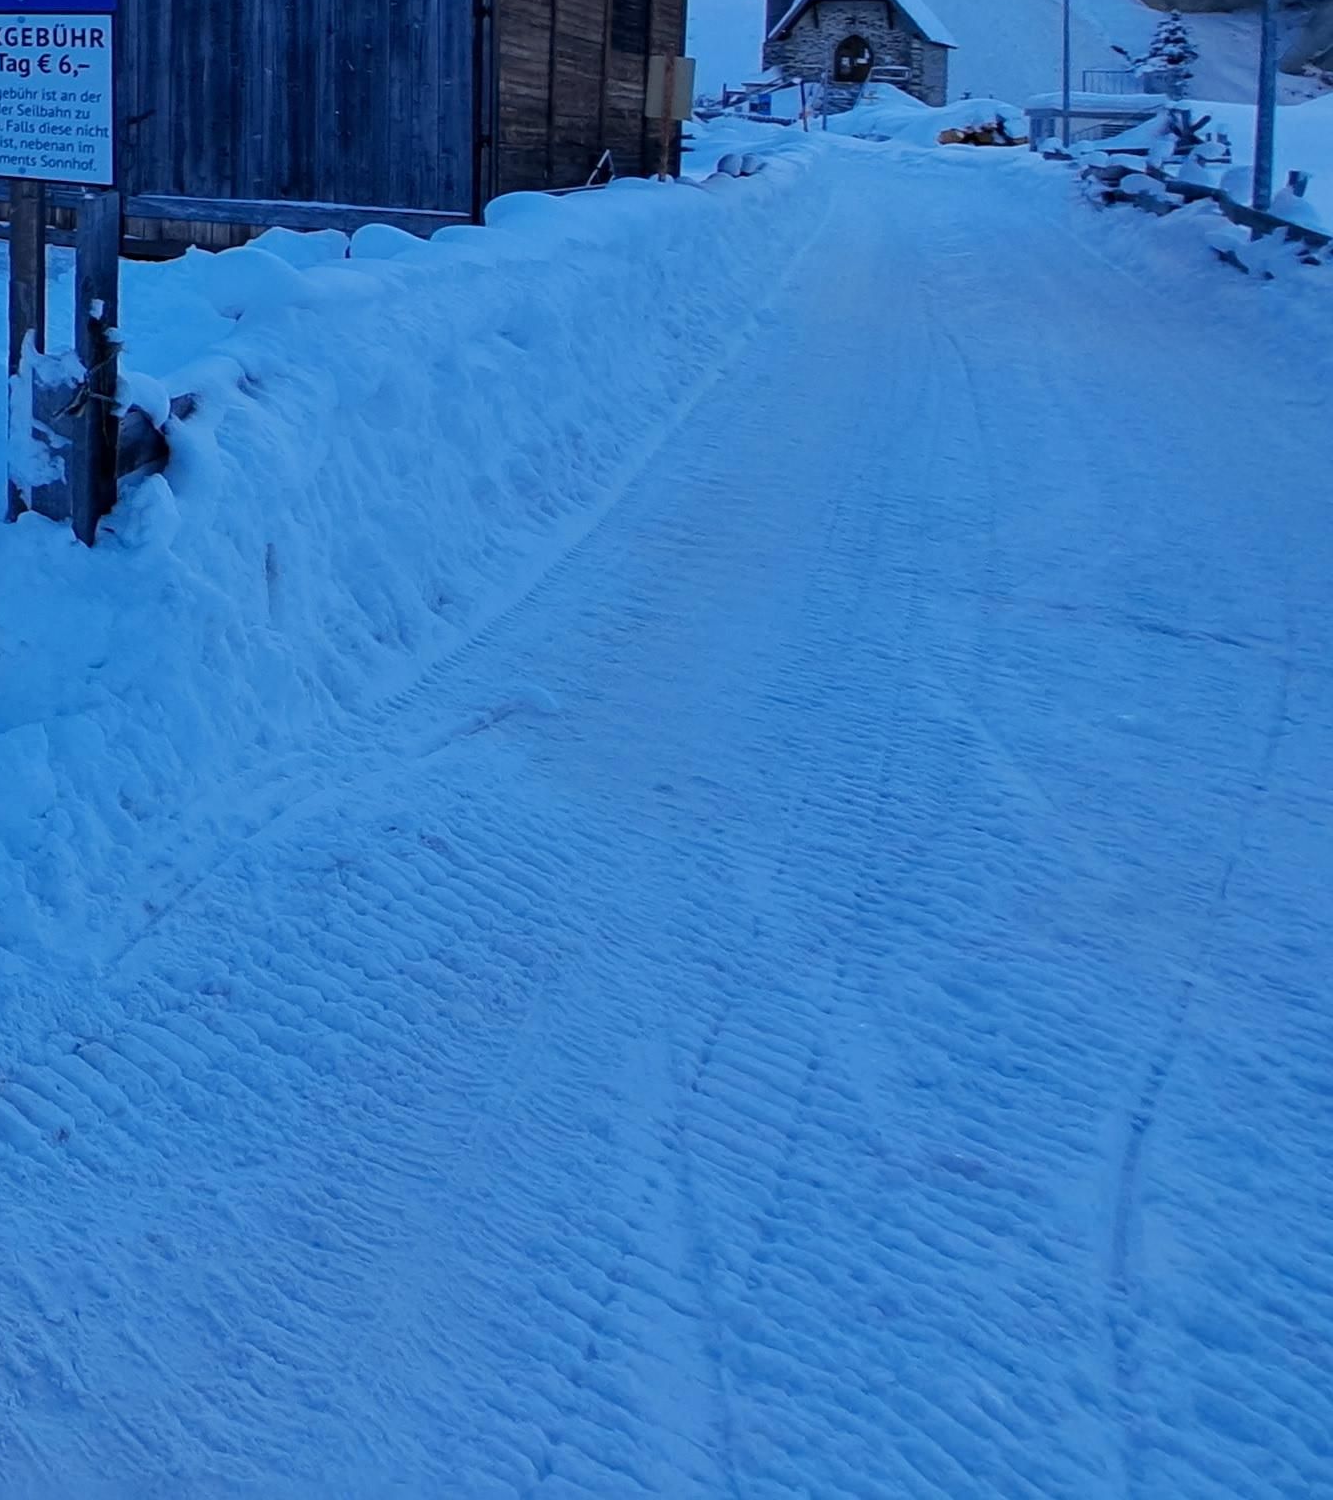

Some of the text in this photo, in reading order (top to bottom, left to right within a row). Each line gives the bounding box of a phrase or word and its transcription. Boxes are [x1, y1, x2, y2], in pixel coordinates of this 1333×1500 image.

[37, 53, 52, 73] €
[41, 89, 57, 101] ist
[61, 91, 76, 102] an
[80, 90, 101, 103] der
[17, 104, 71, 119] Seilbahn
[75, 109, 90, 119] zu
[6, 122, 35, 134] Falls
[39, 123, 72, 136] diese
[76, 125, 109, 138] nicht
[0, 136, 17, 150] ist,
[20, 138, 74, 153] nebenan
[78, 141, 95, 153] im
[40, 155, 97, 172] Sonnhof.
